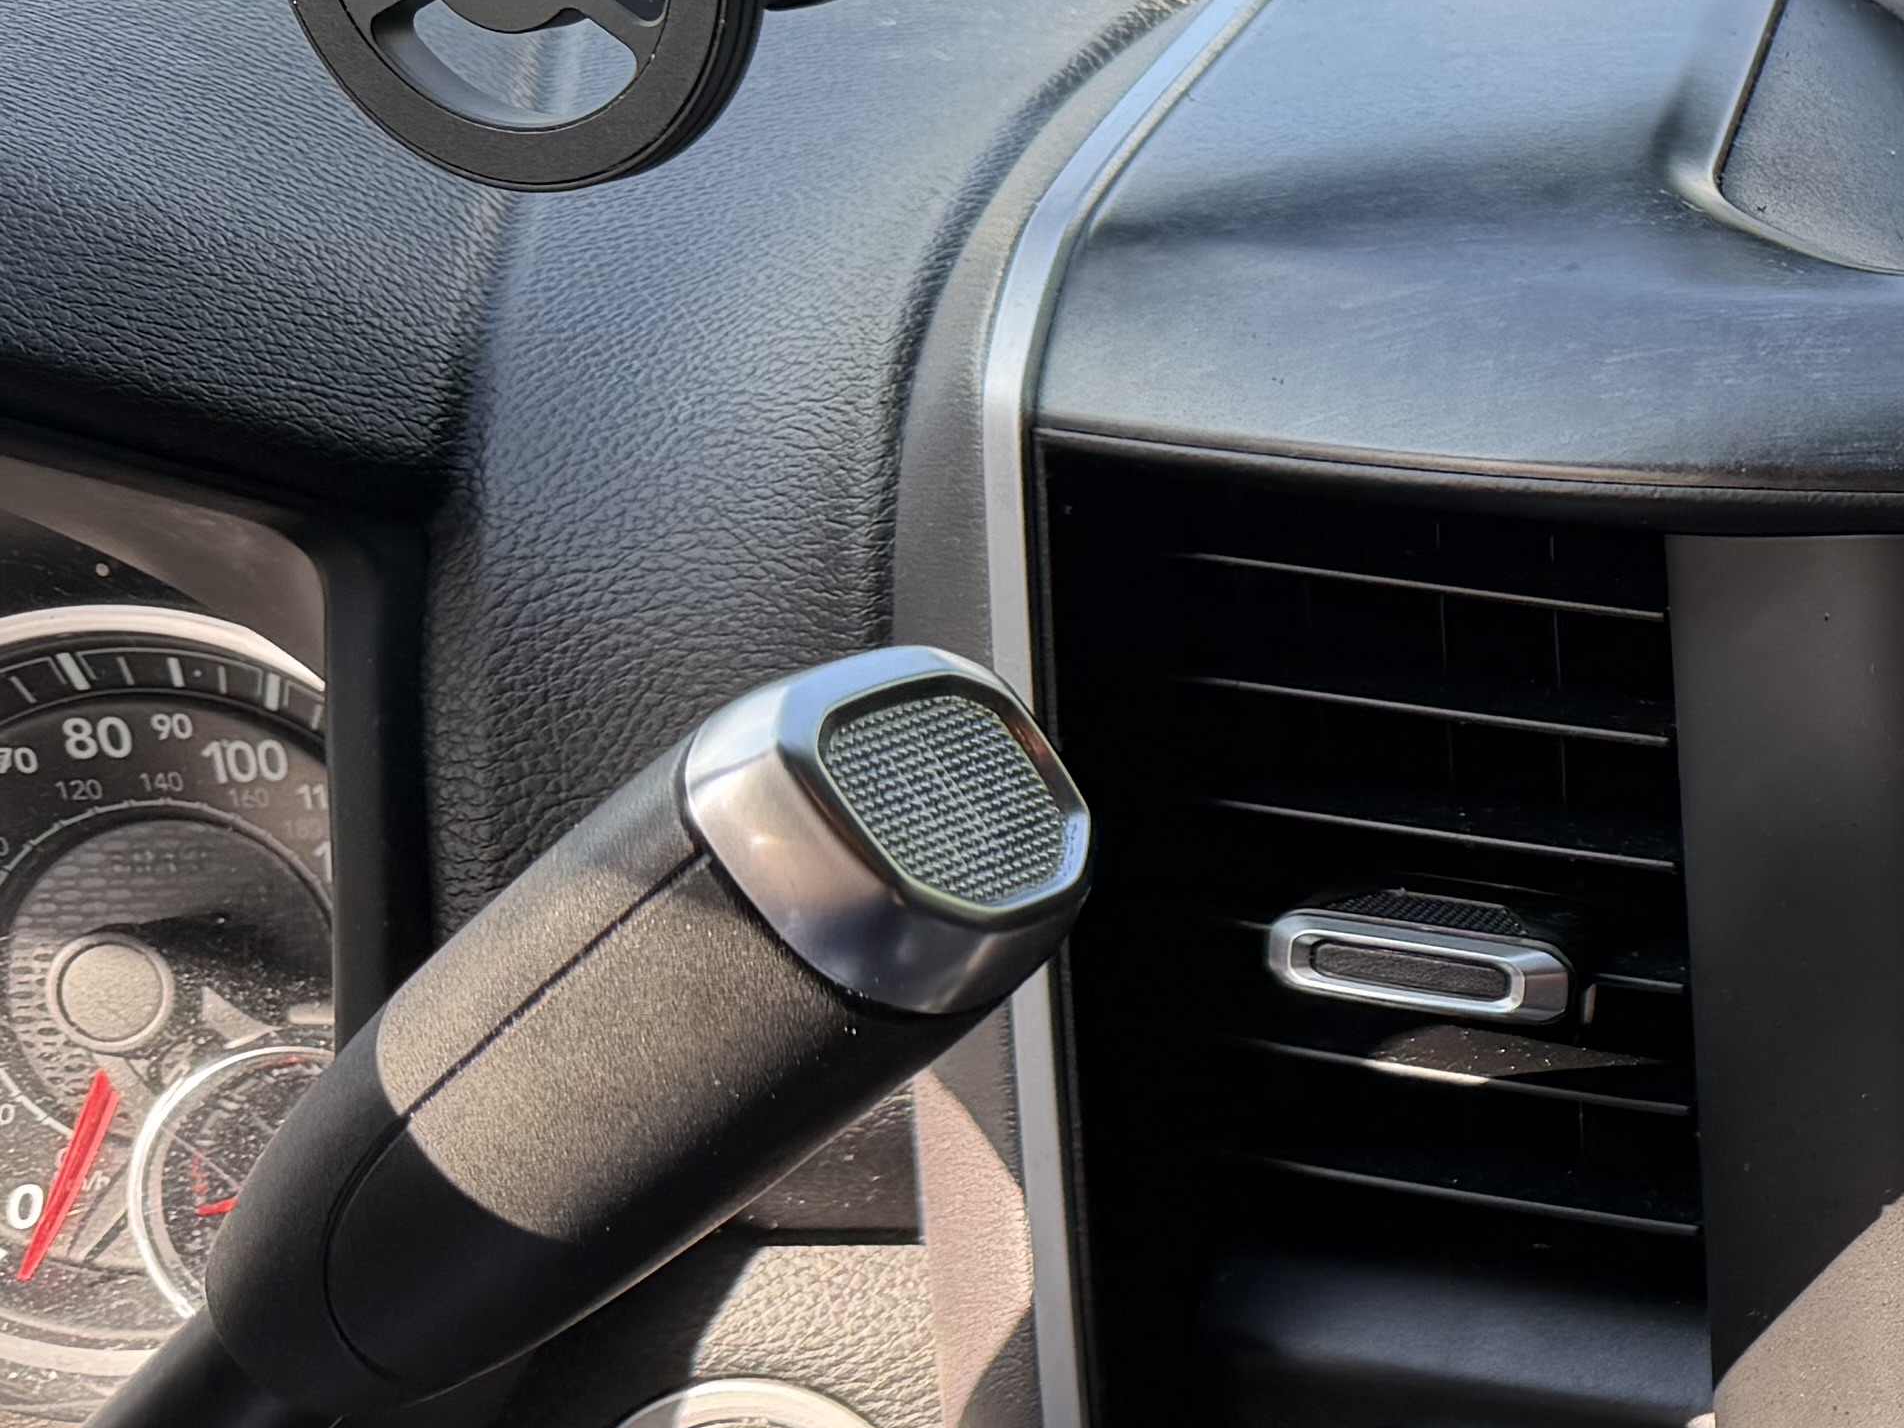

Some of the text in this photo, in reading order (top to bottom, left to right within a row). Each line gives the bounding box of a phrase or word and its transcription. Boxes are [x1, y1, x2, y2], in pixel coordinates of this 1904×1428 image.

[62, 716, 133, 760] 80
[151, 713, 193, 740] 90
[202, 739, 288, 784] 100
[55, 779, 103, 801] 120
[139, 771, 184, 793] 140
[296, 784, 329, 811] 11
[7, 1183, 44, 1230] 0
